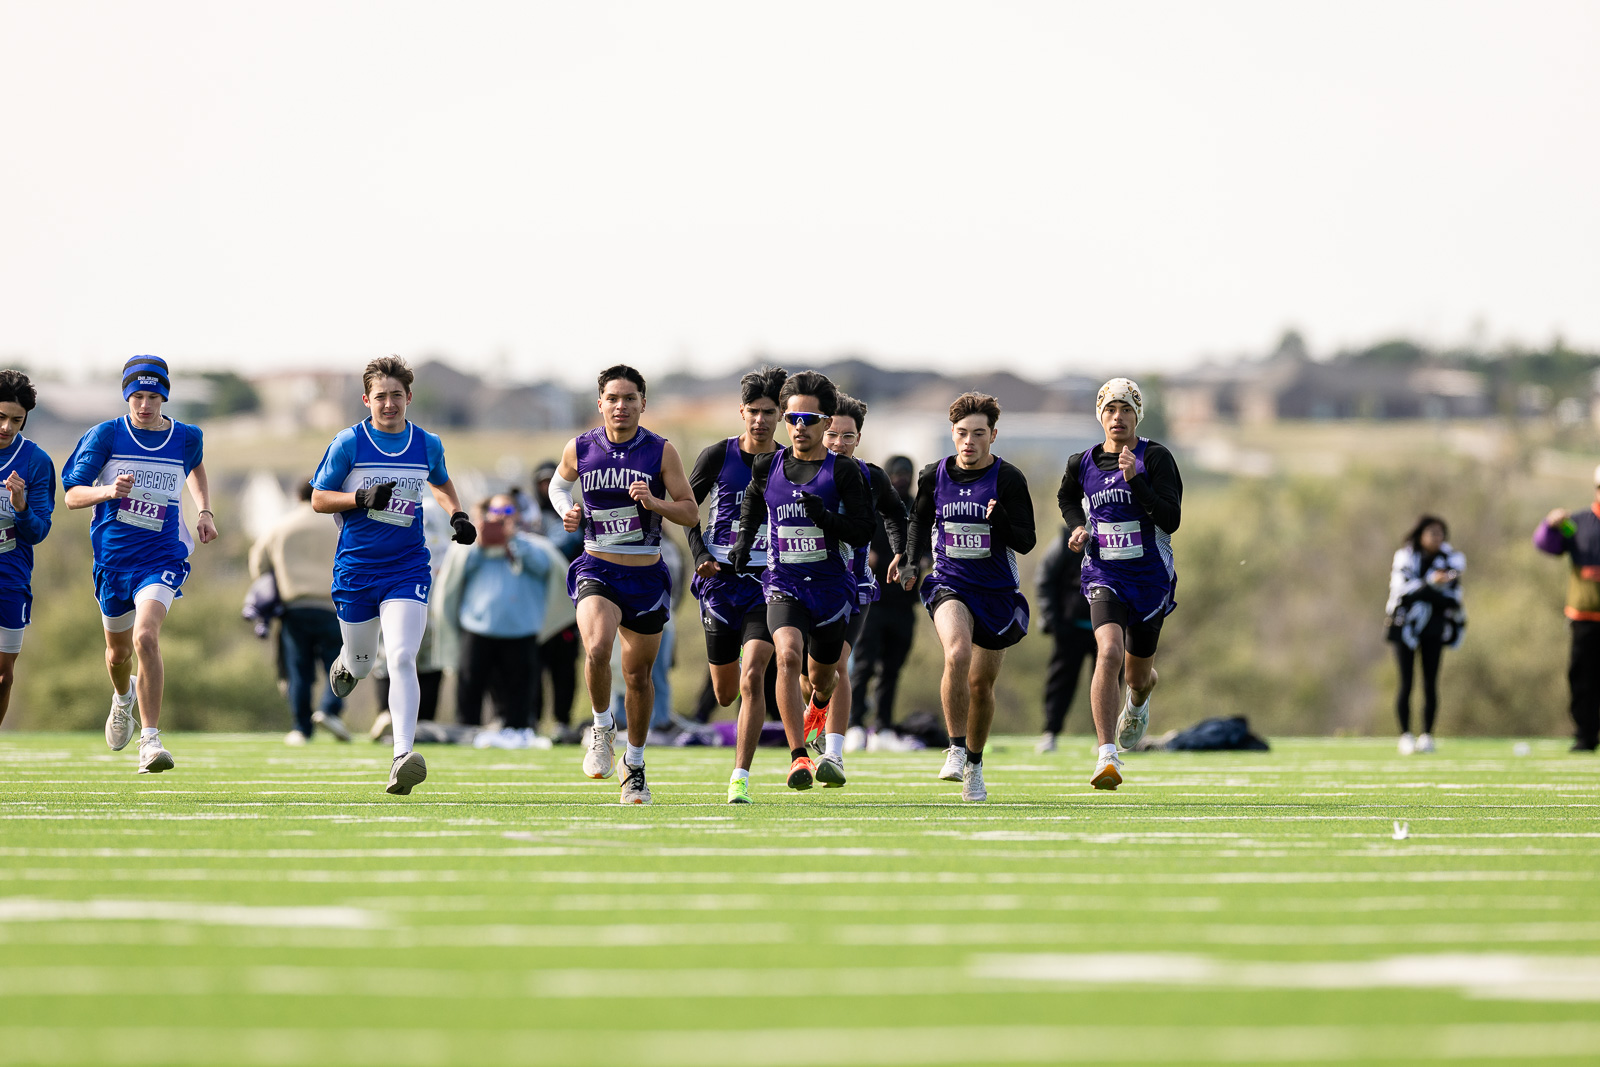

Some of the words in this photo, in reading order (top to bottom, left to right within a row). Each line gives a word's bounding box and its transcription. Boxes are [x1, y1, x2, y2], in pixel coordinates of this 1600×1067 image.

[117, 468, 177, 491] BCATS
[385, 498, 410, 514] 127
[1090, 488, 1132, 510] DIMMITT
[127, 499, 159, 518] 1123
[602, 518, 632, 534] 1167
[752, 535, 768, 550] 73
[786, 538, 817, 552] 1168
[952, 534, 982, 548] 1169
[1105, 533, 1134, 548] 1171
